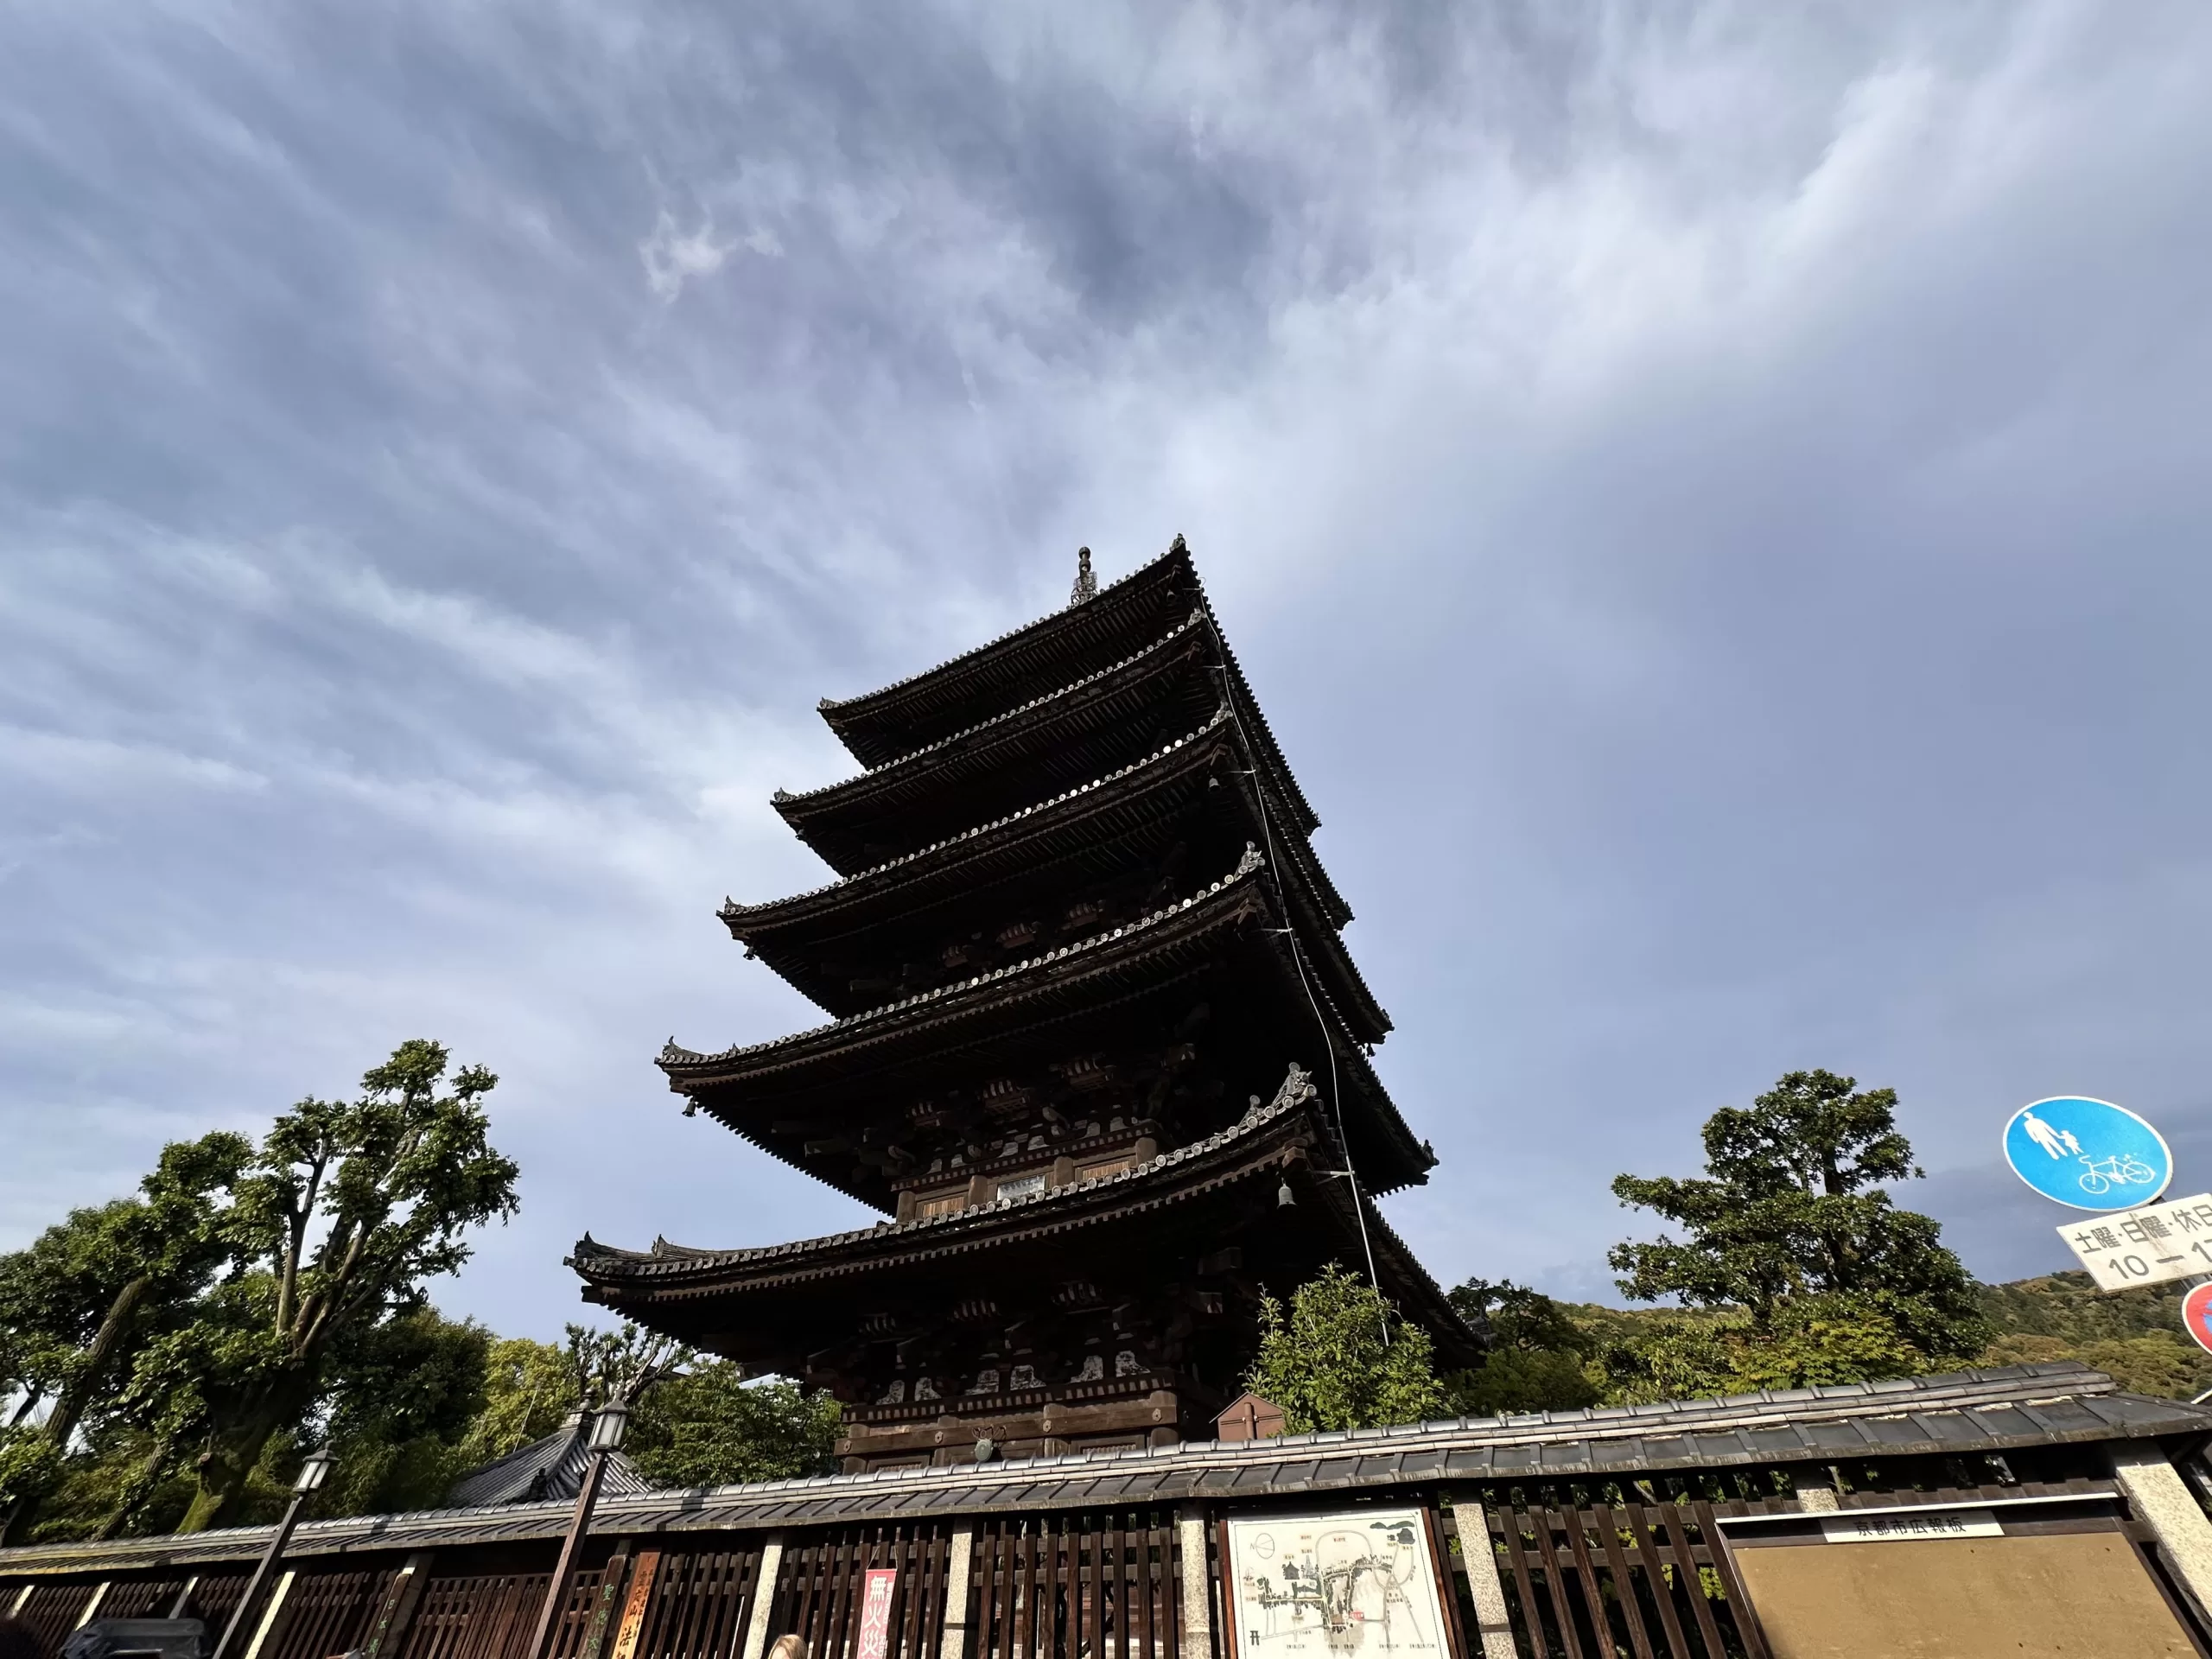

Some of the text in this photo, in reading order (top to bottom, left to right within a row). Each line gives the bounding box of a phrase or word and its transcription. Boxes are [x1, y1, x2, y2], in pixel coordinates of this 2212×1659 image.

[2075, 1205, 2212, 1254] 土曜・日曜・休日
[1853, 1516, 1967, 1536] 京都市広報板
[861, 1575, 887, 1659] 無火災
